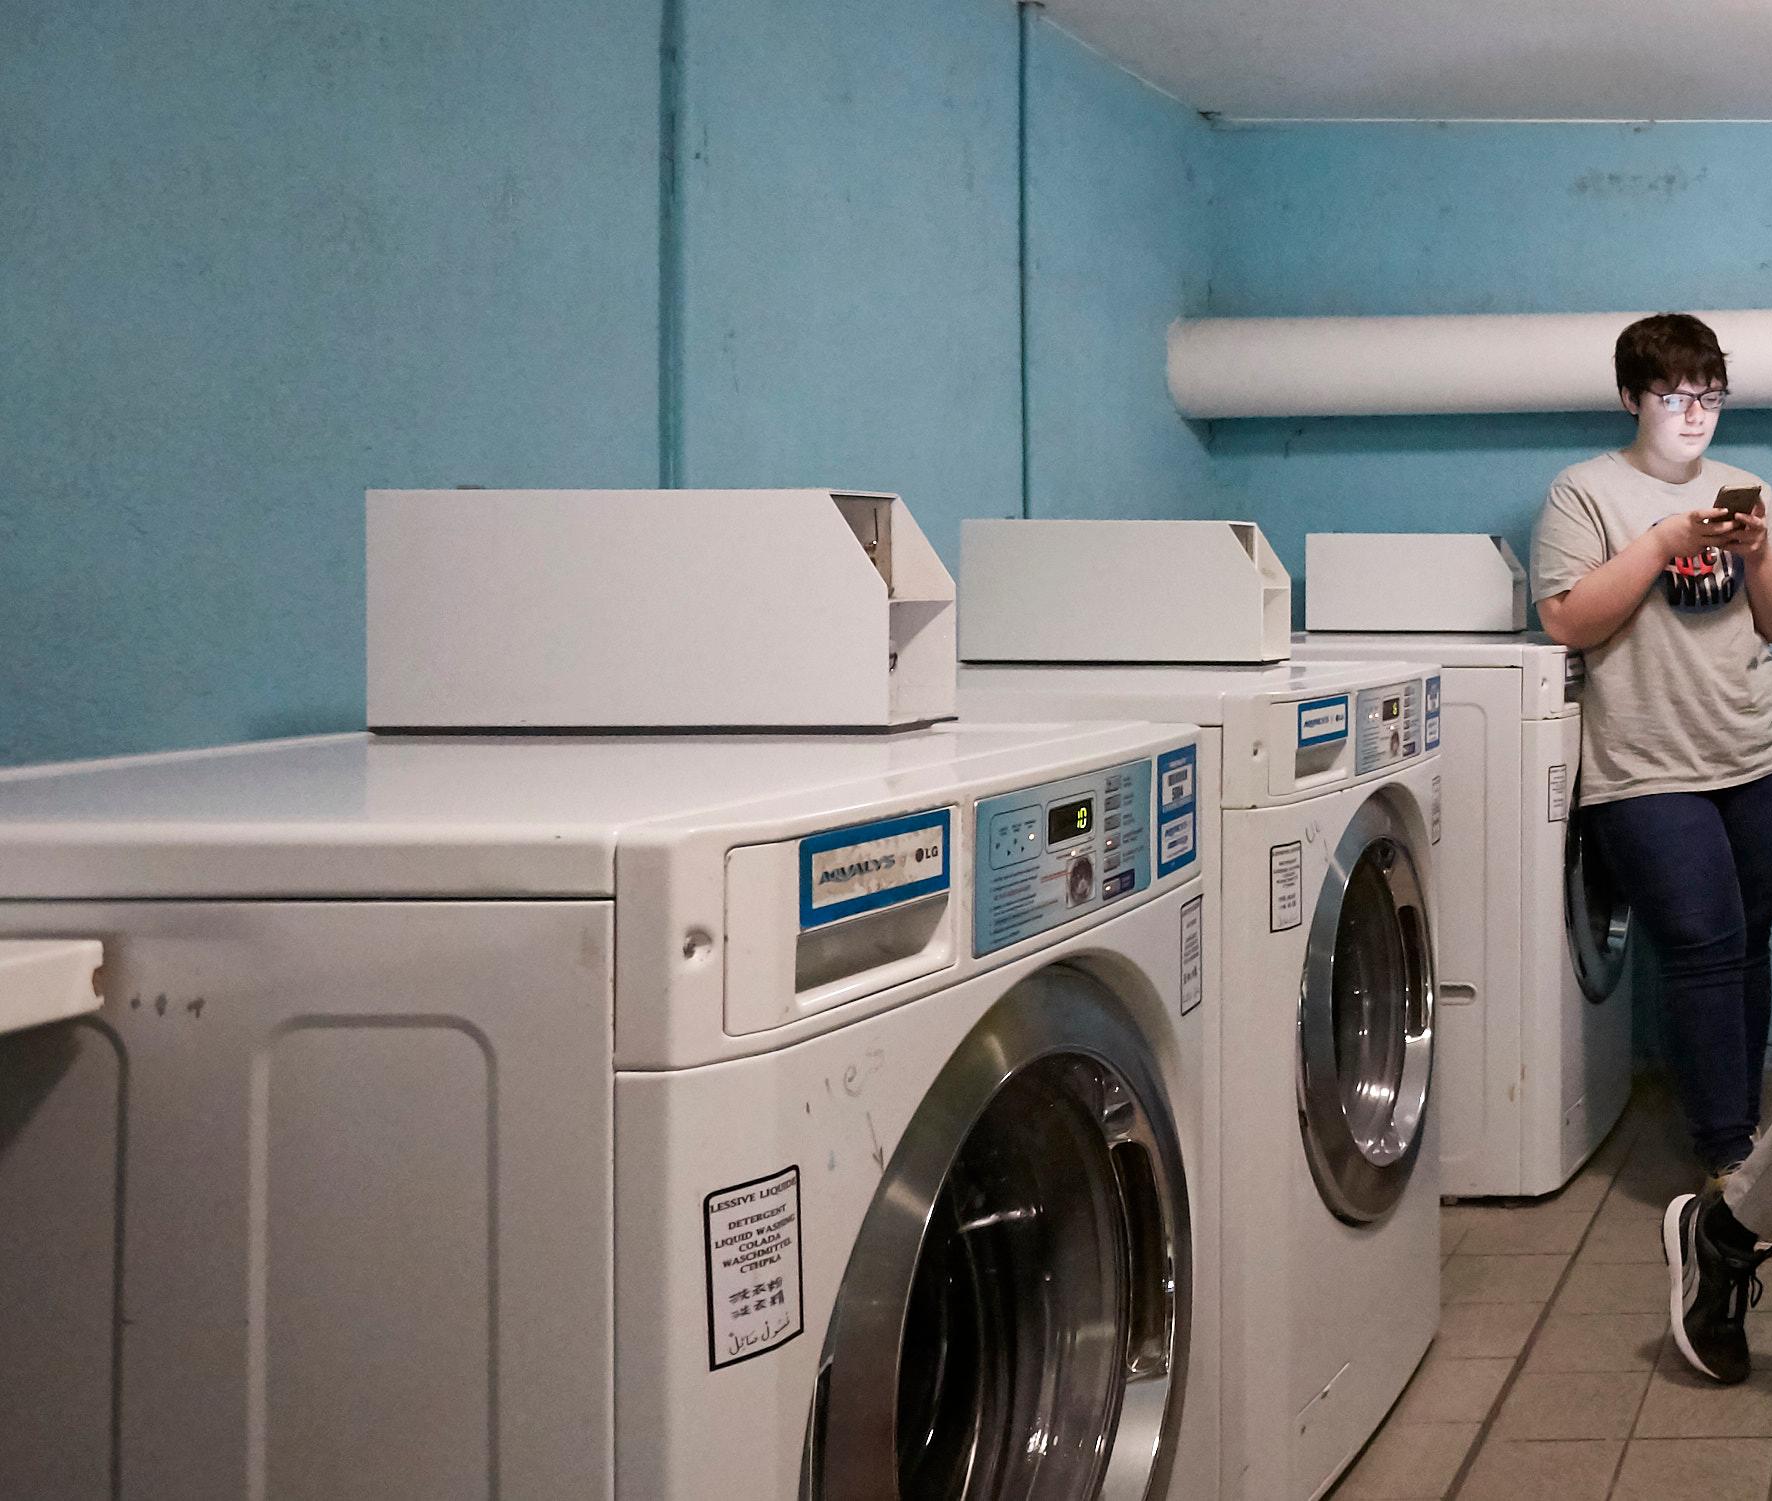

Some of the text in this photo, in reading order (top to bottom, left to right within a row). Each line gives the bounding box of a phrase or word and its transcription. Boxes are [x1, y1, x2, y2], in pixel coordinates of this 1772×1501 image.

[925, 846, 939, 859] LG
[710, 1178, 797, 1213] LESSIVE LIQUIDE
[728, 1203, 787, 1230] DETERGENT
[715, 1213, 795, 1249] LIQUID WASHING
[738, 1233, 781, 1252] COLADA
